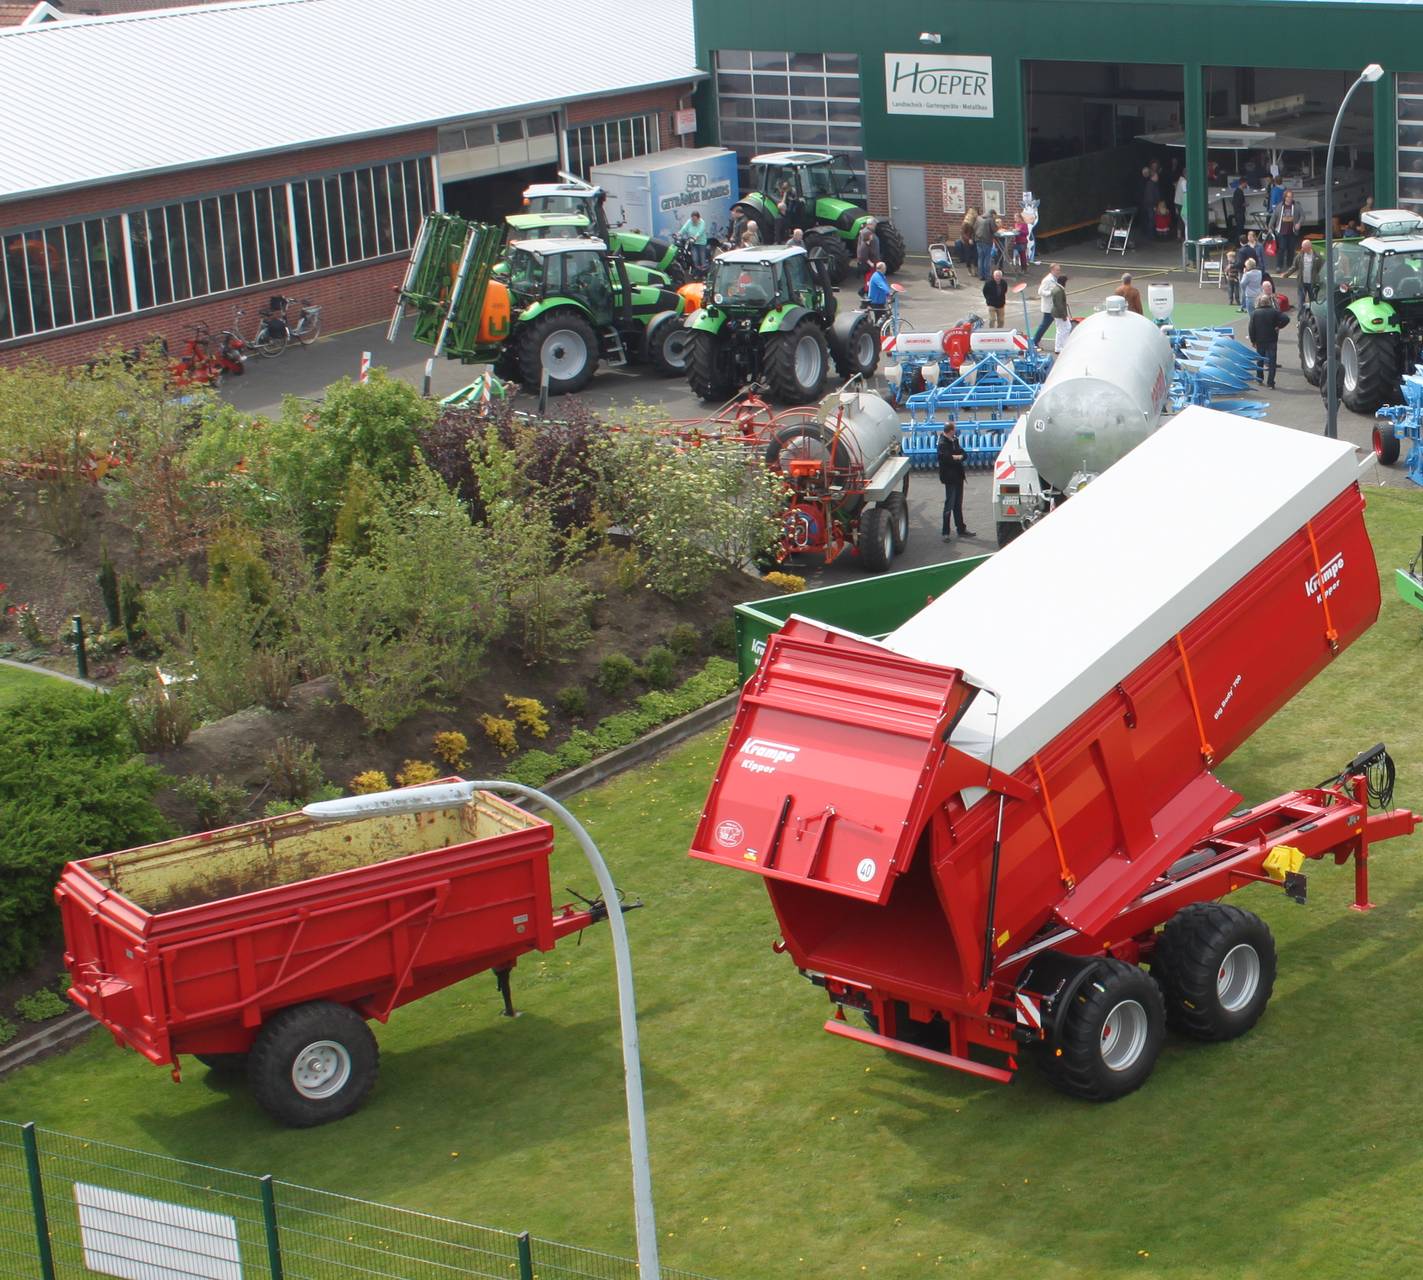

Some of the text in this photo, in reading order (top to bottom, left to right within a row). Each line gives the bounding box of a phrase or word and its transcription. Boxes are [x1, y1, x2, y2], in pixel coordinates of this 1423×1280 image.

[892, 61, 989, 96] HOEPER
[926, 102, 959, 110] Gartengeräte
[661, 191, 700, 210] GETRÄNKE
[1317, 579, 1340, 604] Kpper
[740, 737, 800, 763] Krampe
[741, 759, 776, 774] Kipper
[860, 864, 872, 878] 40
